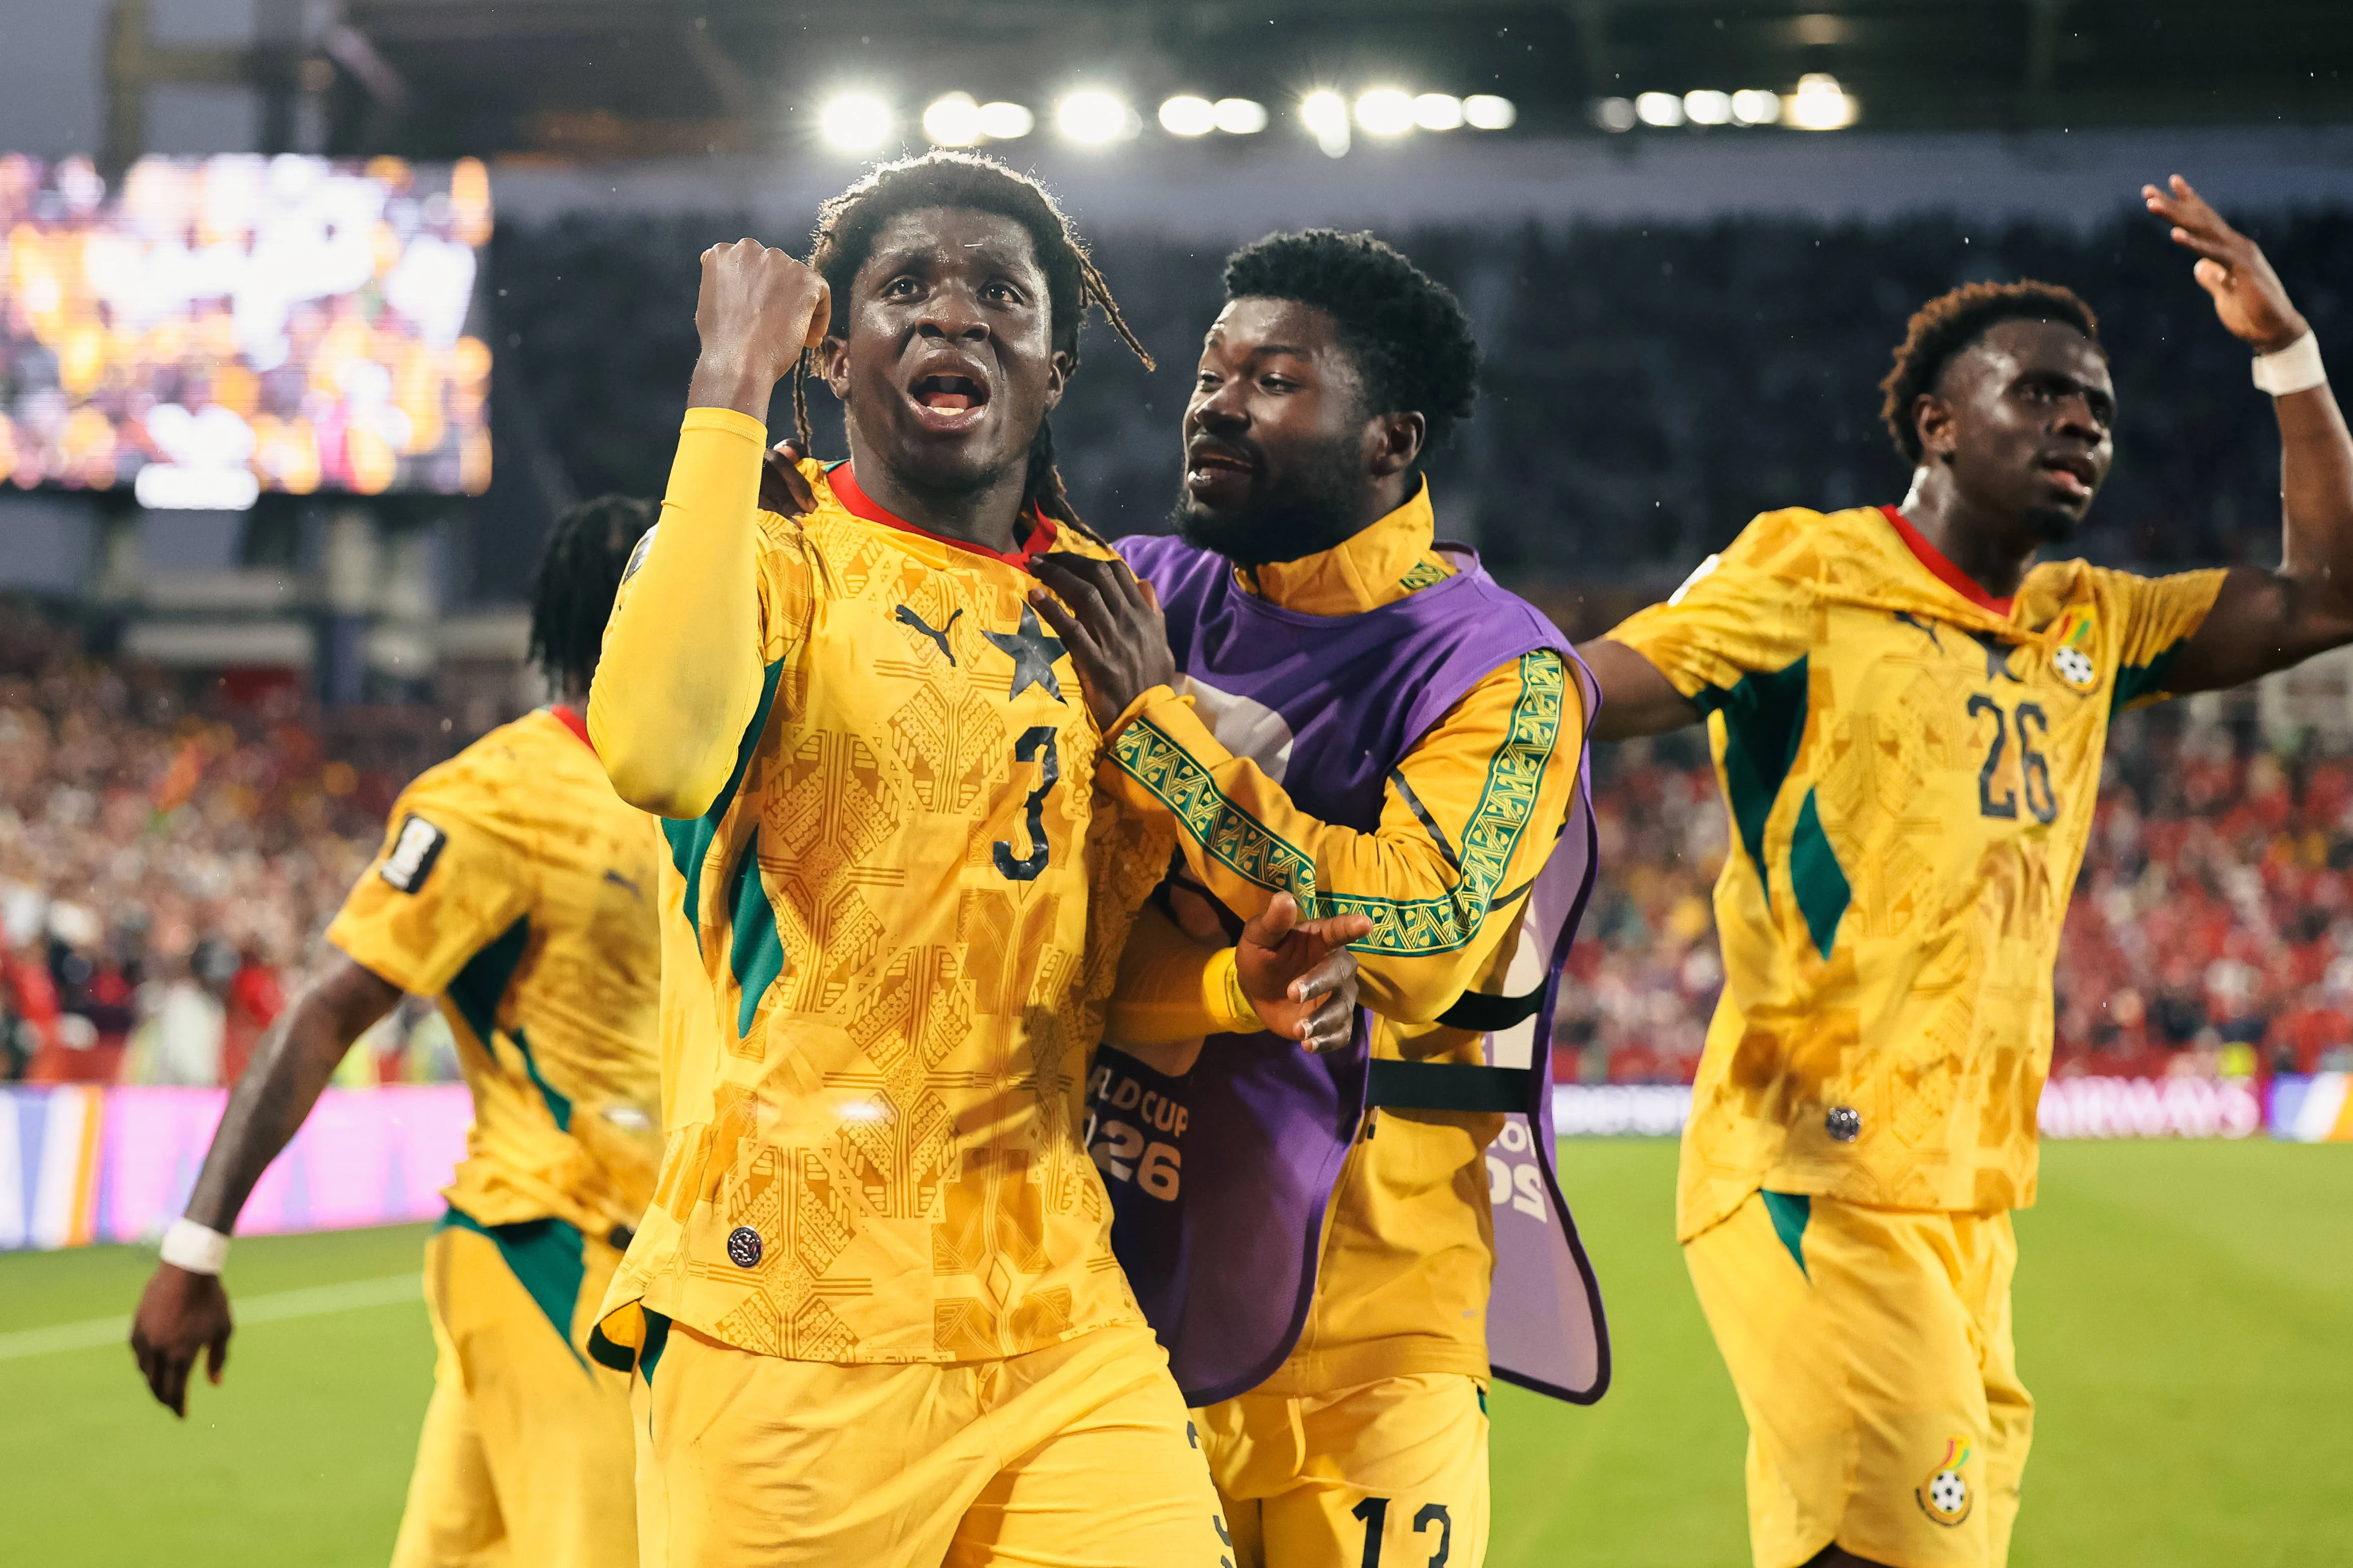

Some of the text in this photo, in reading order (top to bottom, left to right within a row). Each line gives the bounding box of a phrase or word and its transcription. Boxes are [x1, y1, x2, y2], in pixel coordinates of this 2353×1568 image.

[993, 726, 1060, 881] 3
[1967, 691, 2058, 825] 26
[1140, 1090, 1189, 1138] CUP
[1350, 1496, 1451, 1568] 13
